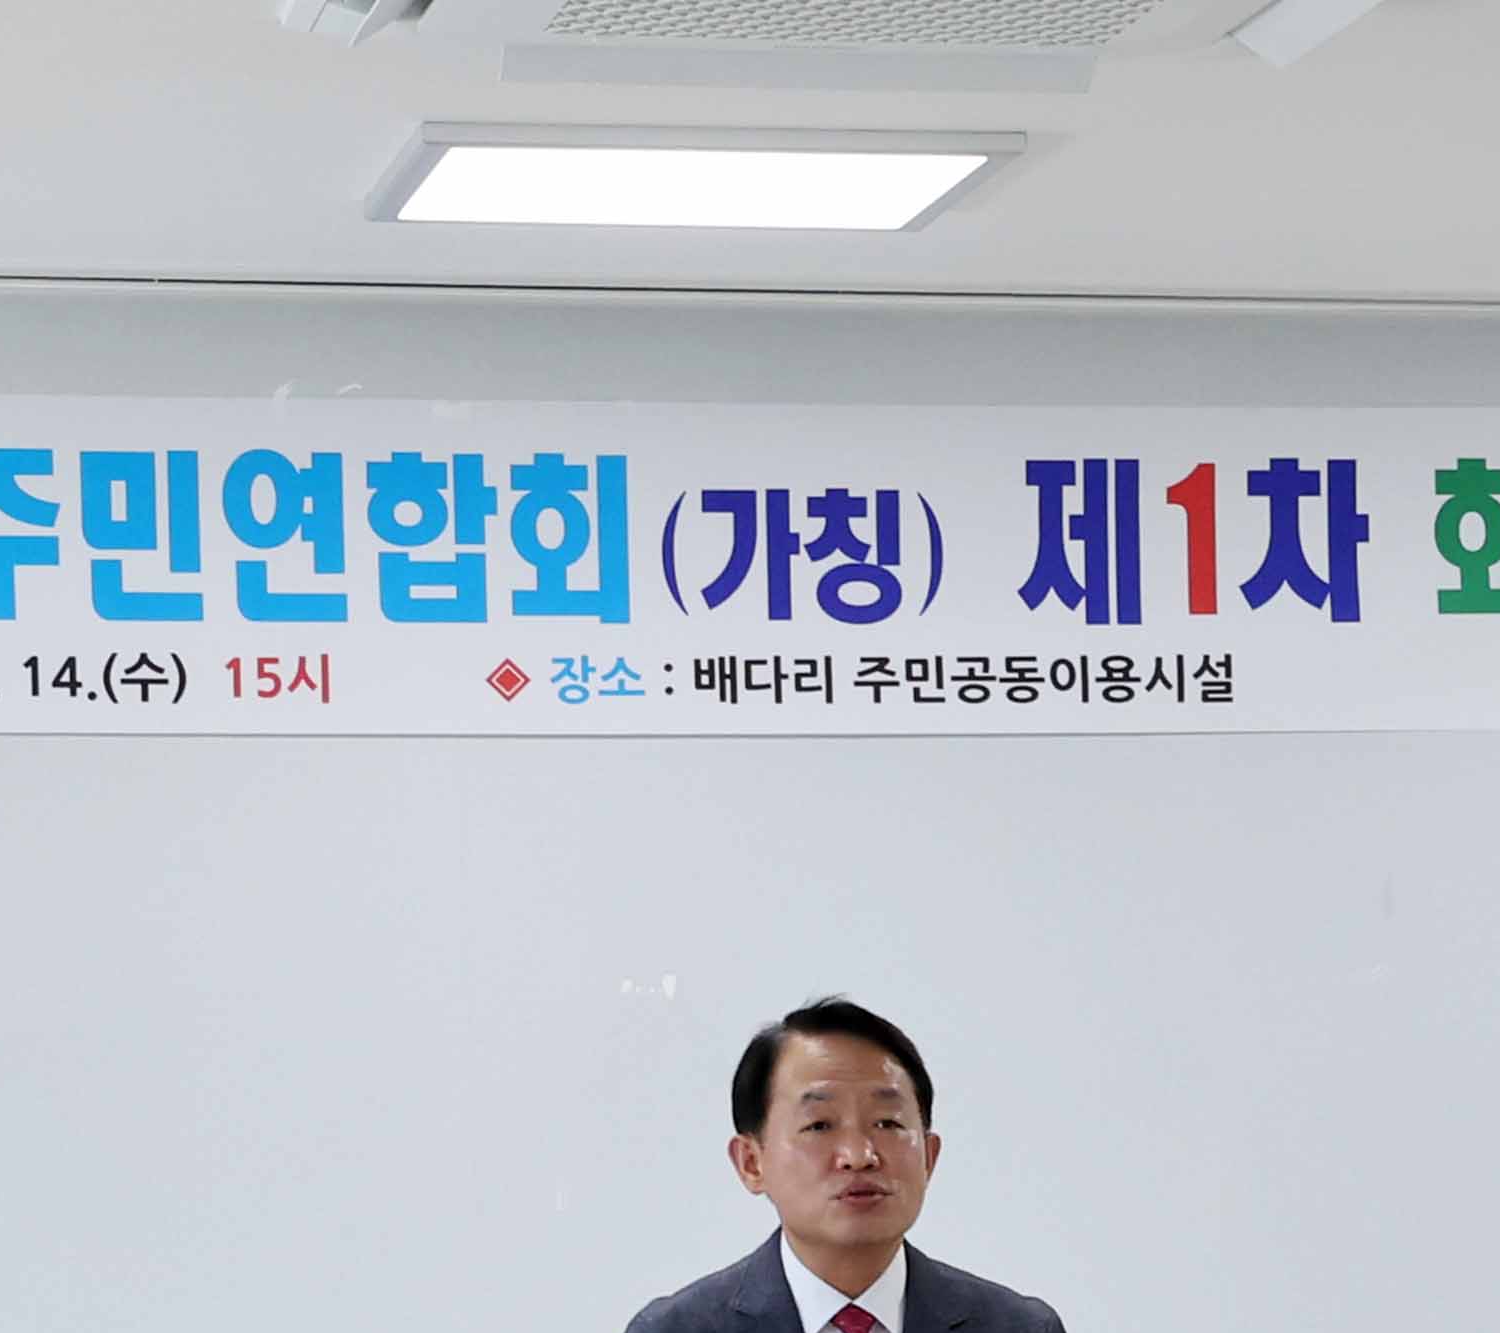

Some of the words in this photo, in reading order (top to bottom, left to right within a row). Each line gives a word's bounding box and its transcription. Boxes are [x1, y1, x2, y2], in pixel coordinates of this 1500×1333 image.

[1017, 457, 1370, 625] 제1차
[22, 652, 187, 705] 14.(수)
[225, 653, 330, 704] 15시
[549, 655, 646, 705] 장소
[693, 655, 834, 705] 배다리
[853, 653, 1234, 704] 주민공동이용시설
